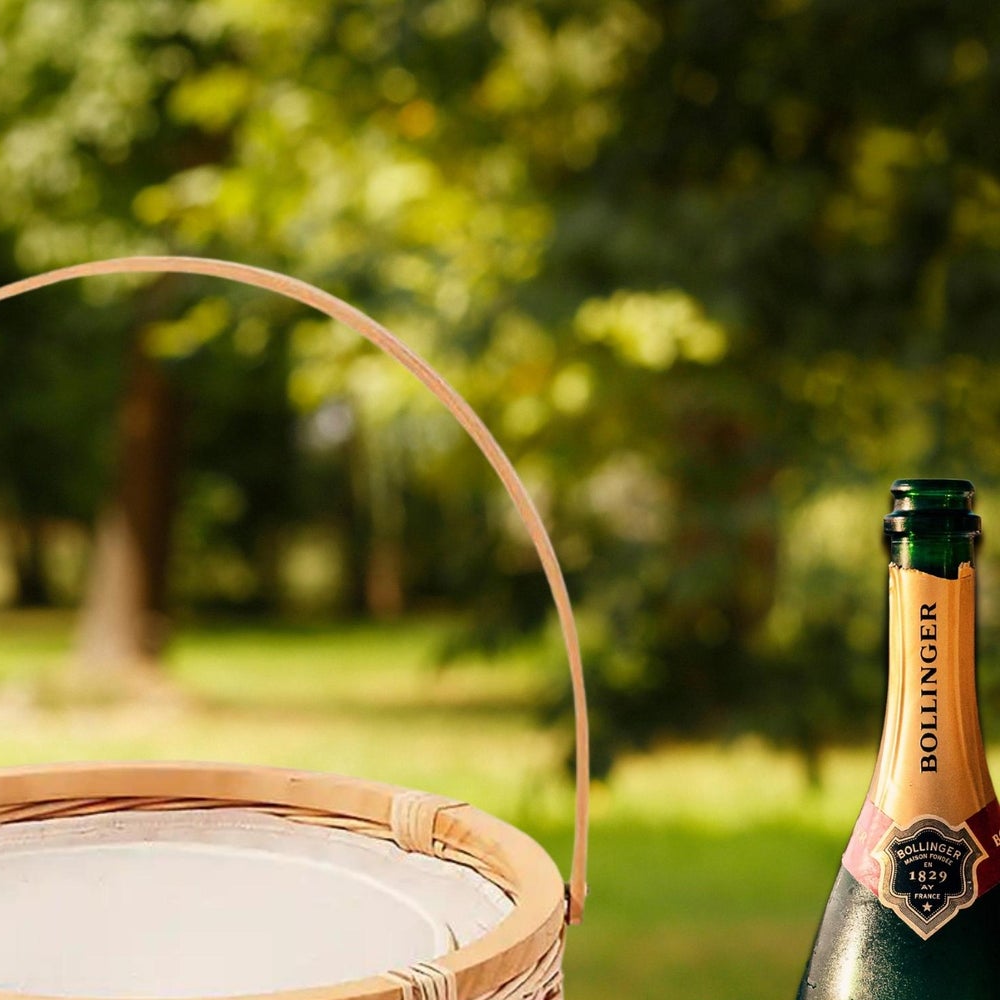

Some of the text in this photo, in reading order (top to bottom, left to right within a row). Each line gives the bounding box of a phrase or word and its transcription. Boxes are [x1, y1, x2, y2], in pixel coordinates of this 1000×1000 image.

[920, 602, 938, 774] BOLLINGER
[896, 841, 962, 860] BOLLINGER
[904, 853, 928, 866] MAISON
[909, 870, 948, 884] 1829
